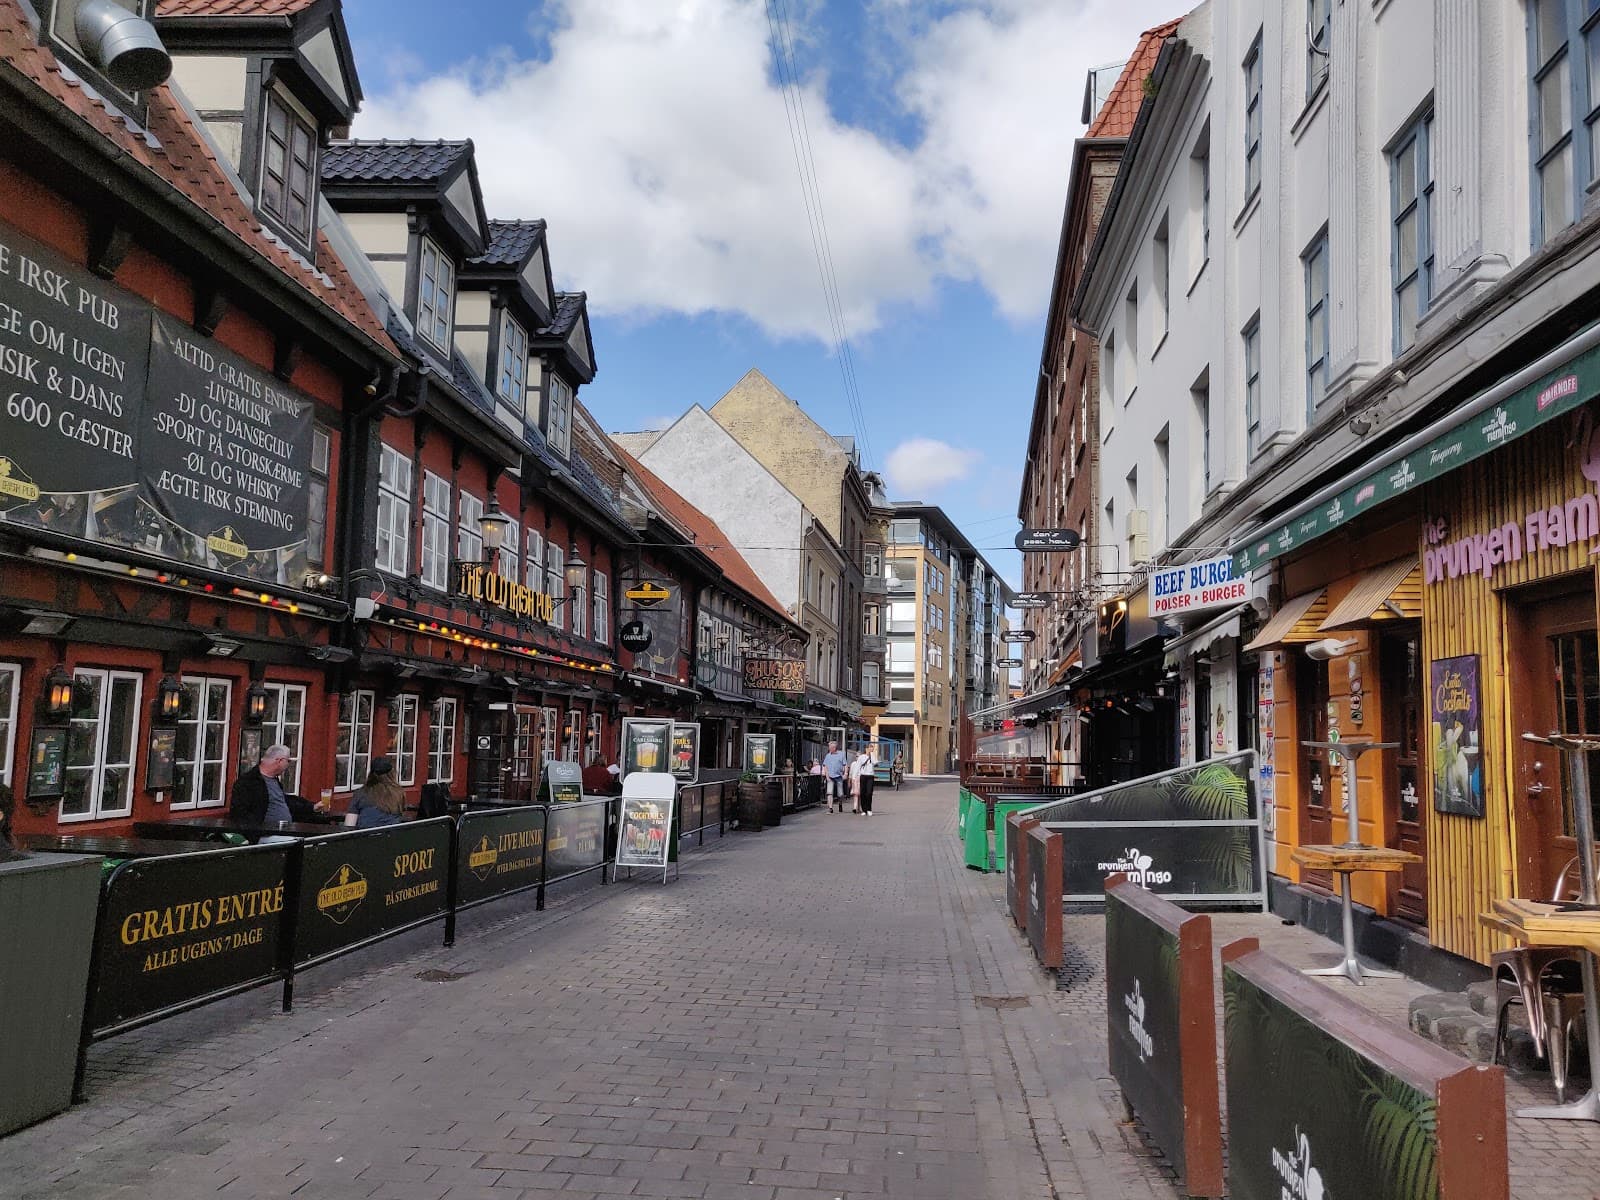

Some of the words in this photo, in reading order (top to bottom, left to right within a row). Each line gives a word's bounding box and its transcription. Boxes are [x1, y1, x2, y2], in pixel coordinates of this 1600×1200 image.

[18, 255, 70, 306] IRSK
[78, 287, 119, 330] PUB
[30, 320, 65, 355] OM
[73, 338, 125, 382] UGEN
[47, 366, 63, 393] &
[70, 375, 123, 417] DANS
[205, 381, 273, 427] -LIVEMUSIK
[219, 362, 262, 399] GRATIS
[264, 386, 300, 419] ENTRÉ
[1540, 377, 1577, 406] SMIRNOFF
[7, 393, 51, 427] 600
[59, 411, 133, 458] GÆSTER
[153, 412, 205, 447] -SPORT
[208, 432, 223, 456] PÅ
[227, 442, 301, 488] STORSKÆRME
[174, 393, 196, 419] -DJ
[200, 403, 222, 428] OG
[226, 415, 293, 459] DANSEGULV
[157, 470, 199, 500] ÆGTE
[203, 484, 232, 511] IRSK
[235, 496, 293, 532] STEMNING
[211, 461, 232, 484] OG
[236, 470, 282, 502] WHISKY
[461, 564, 484, 599] THE
[486, 571, 508, 608] OLD
[510, 581, 534, 618] IRISH
[536, 591, 553, 622] PUB
[1155, 570, 1185, 596] BEEF
[1190, 559, 1245, 589] BURGE
[1155, 594, 1191, 612] PØLSER
[1202, 583, 1246, 603] BURGER
[393, 848, 435, 878] SPORT
[498, 833, 518, 852] LIVE
[518, 829, 543, 848] MUSIK
[121, 899, 212, 945] GRATIS
[216, 880, 285, 925] ENTRÉ
[142, 951, 178, 972] ALLE
[181, 937, 222, 962] UGENS
[225, 935, 231, 951] 7
[232, 928, 263, 949] DAGE
